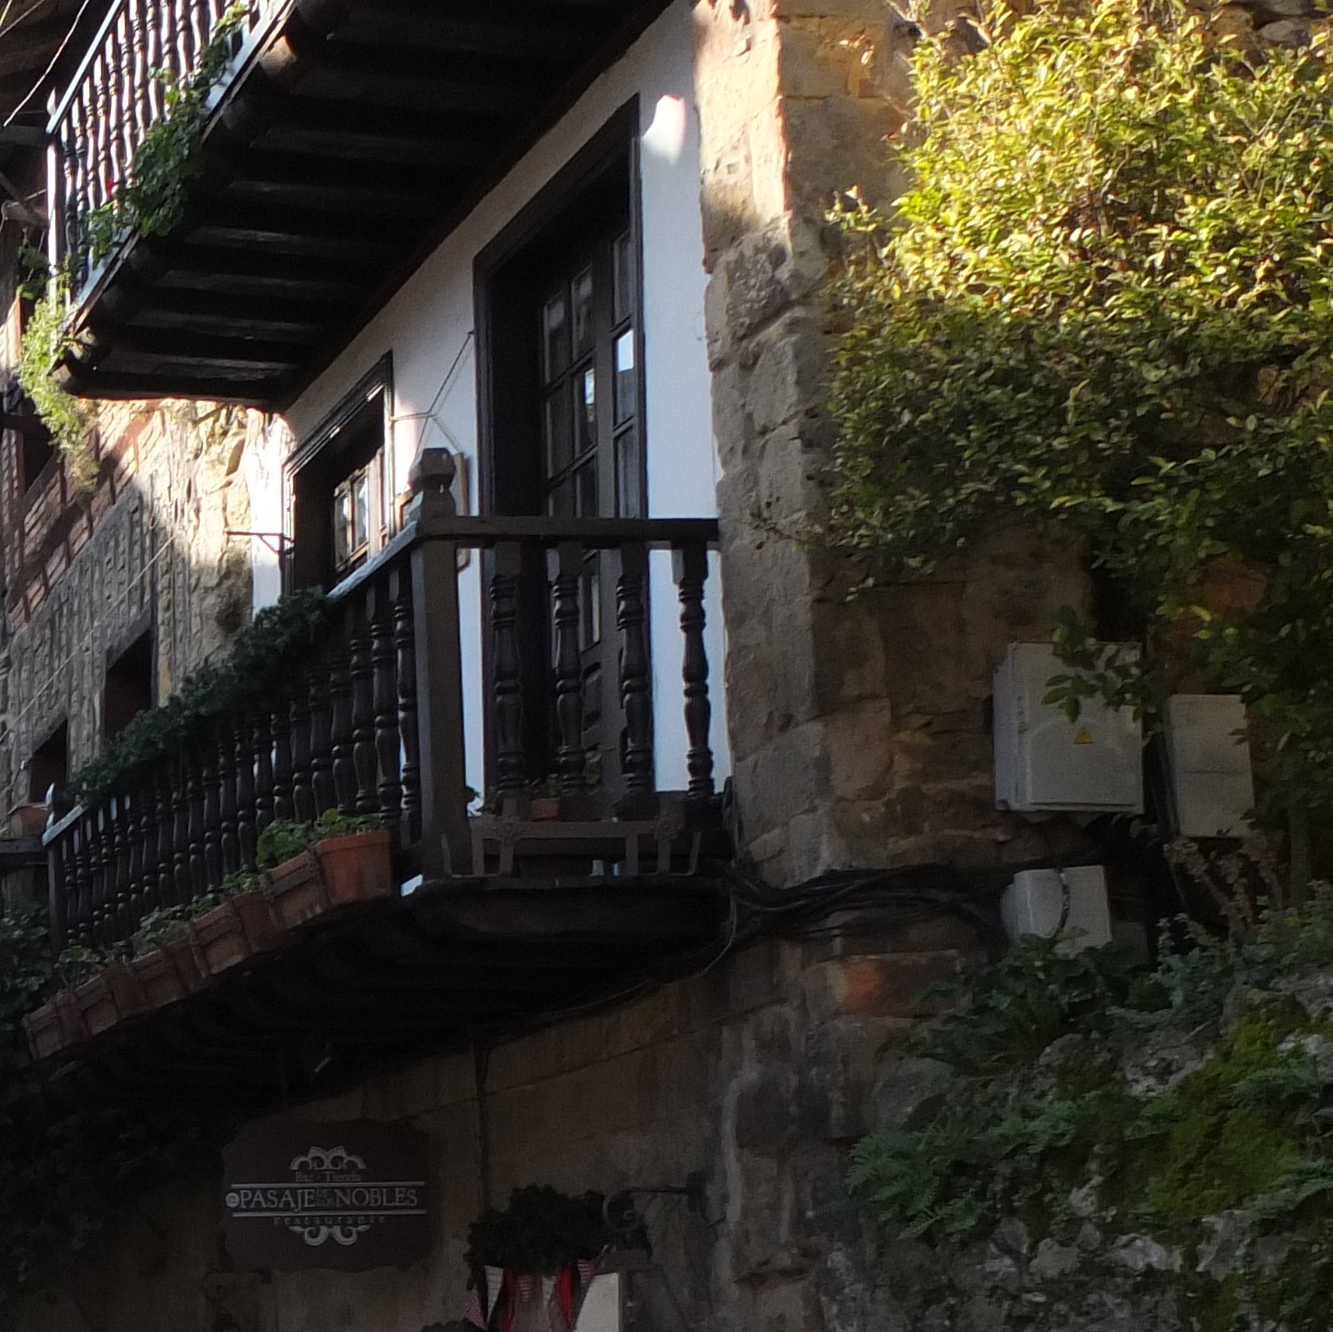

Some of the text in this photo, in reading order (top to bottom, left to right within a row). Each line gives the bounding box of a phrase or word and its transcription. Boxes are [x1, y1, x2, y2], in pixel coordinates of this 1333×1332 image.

[295, 1171, 314, 1183] Bar
[240, 1188, 316, 1212] PASAJE
[334, 1186, 419, 1207] NOBLES
[273, 1215, 386, 1226] restaurante
